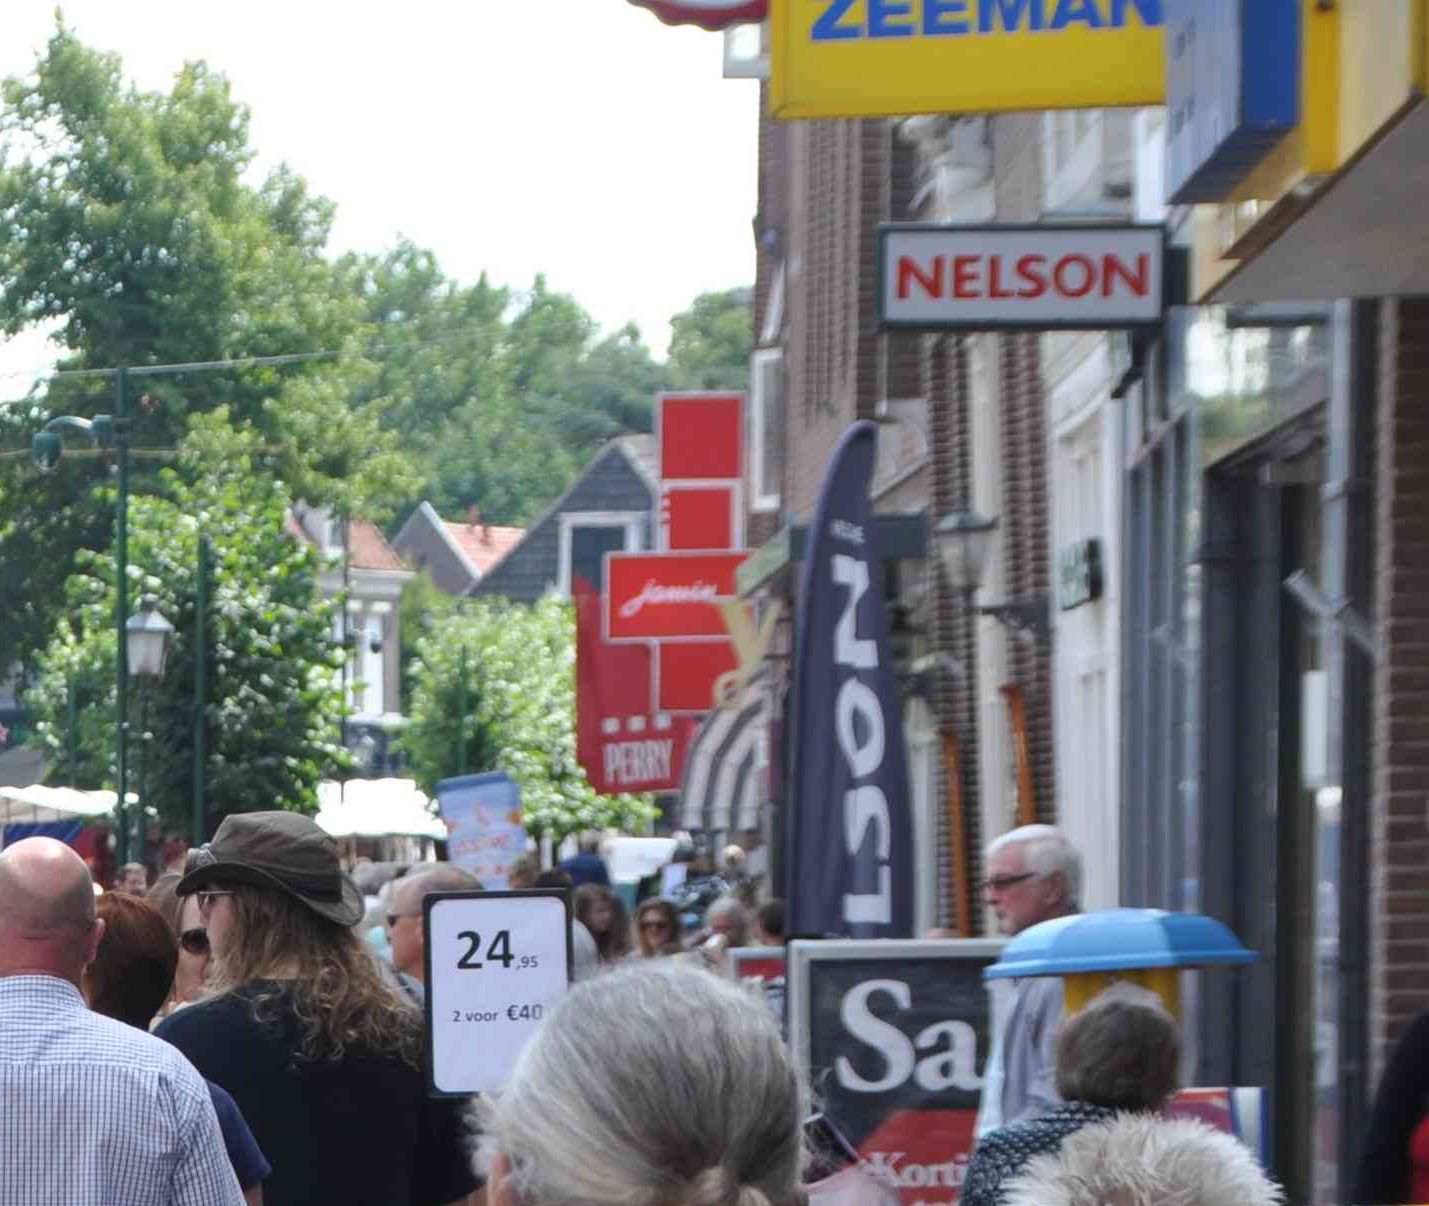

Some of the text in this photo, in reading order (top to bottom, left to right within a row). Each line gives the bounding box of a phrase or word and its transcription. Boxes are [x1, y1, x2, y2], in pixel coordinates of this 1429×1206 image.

[895, 253, 1150, 299] NELSON
[618, 579, 718, 618] jamin
[604, 738, 674, 784] PERRY
[830, 554, 892, 924] LSON
[453, 1011, 461, 1022] 2
[465, 1012, 499, 1022] voor
[835, 979, 984, 1093] Sa
[868, 1151, 968, 1187] Korti
